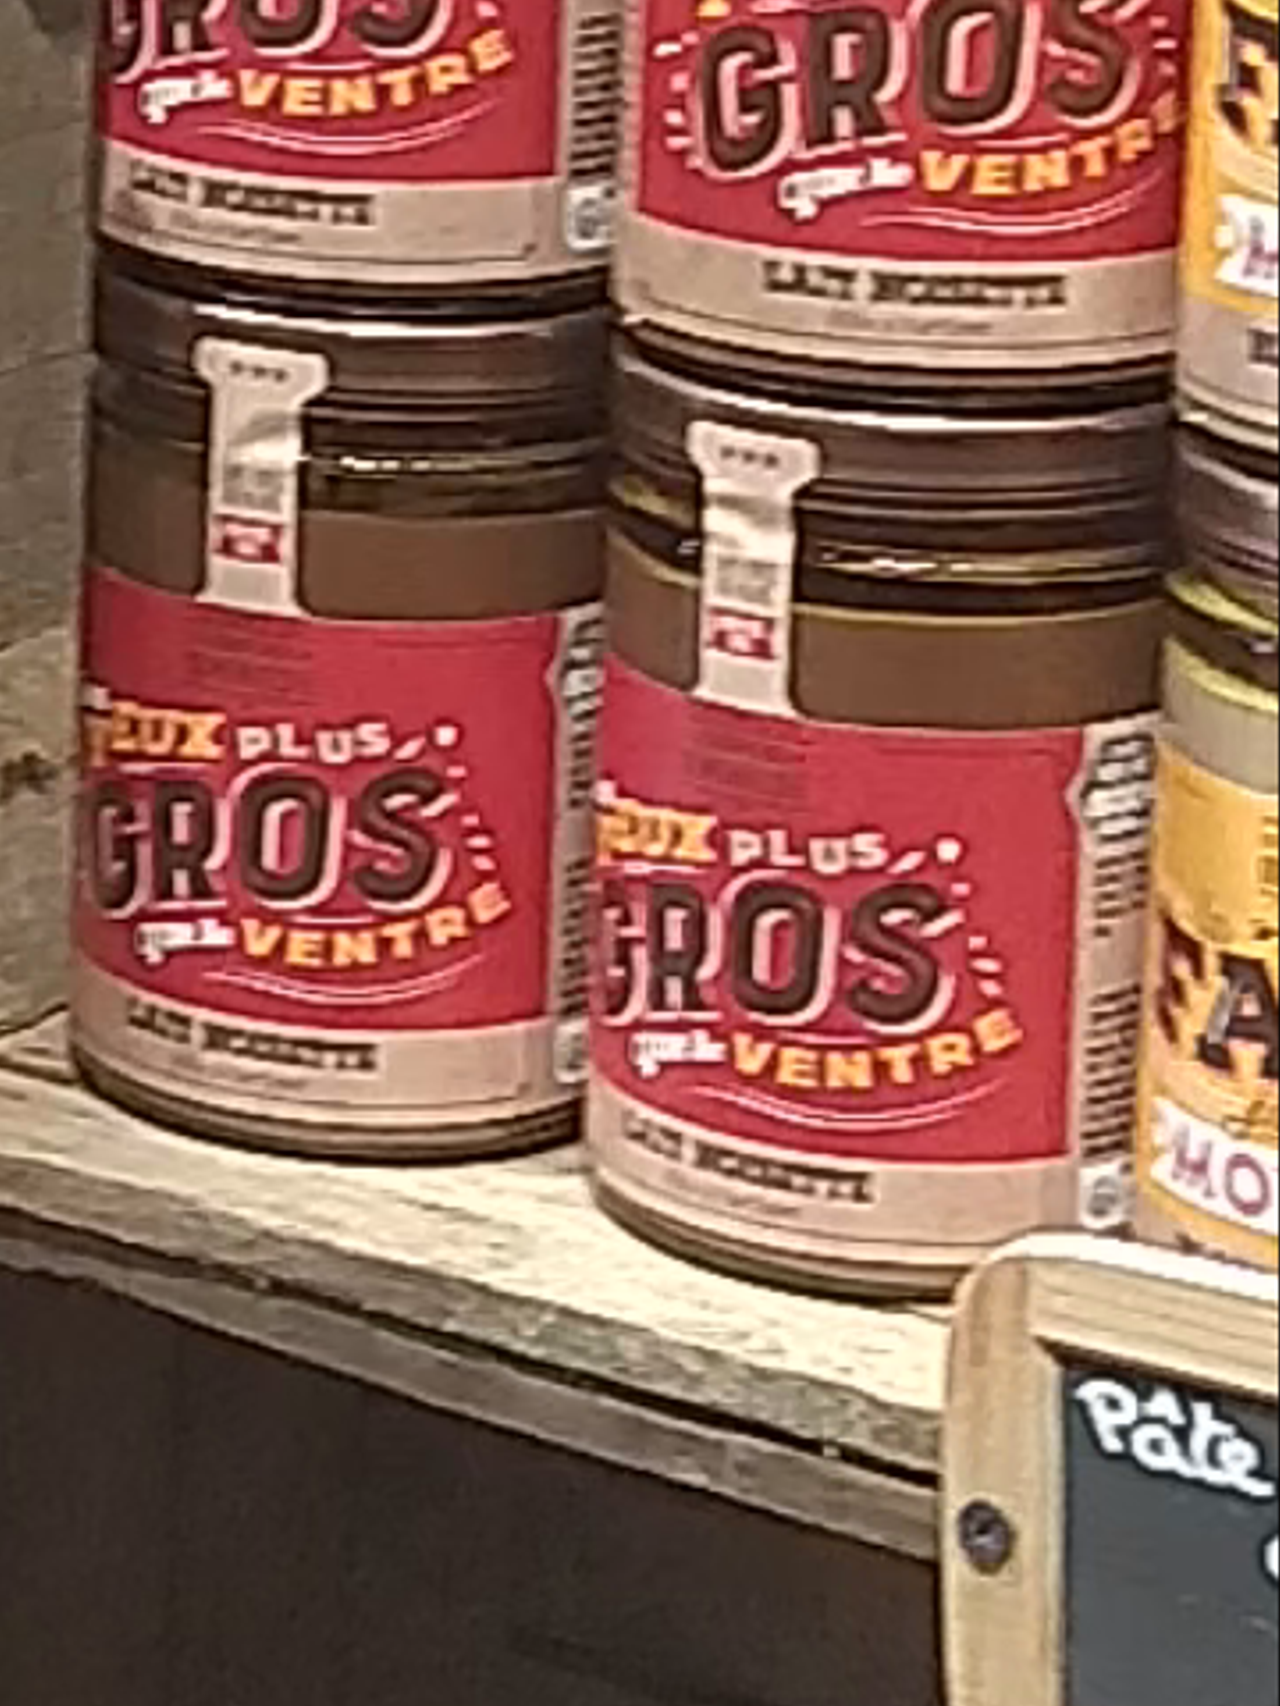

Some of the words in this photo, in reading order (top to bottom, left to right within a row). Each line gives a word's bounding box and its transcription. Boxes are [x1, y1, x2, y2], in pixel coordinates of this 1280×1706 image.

[237, 28, 513, 117] VENTRE
[237, 723, 390, 764] PLUS
[89, 767, 452, 914] GROS
[597, 799, 718, 864] EUX
[726, 828, 888, 873] PLUS
[240, 883, 511, 966] VENTRE
[732, 1008, 1023, 1087] VENTRE
